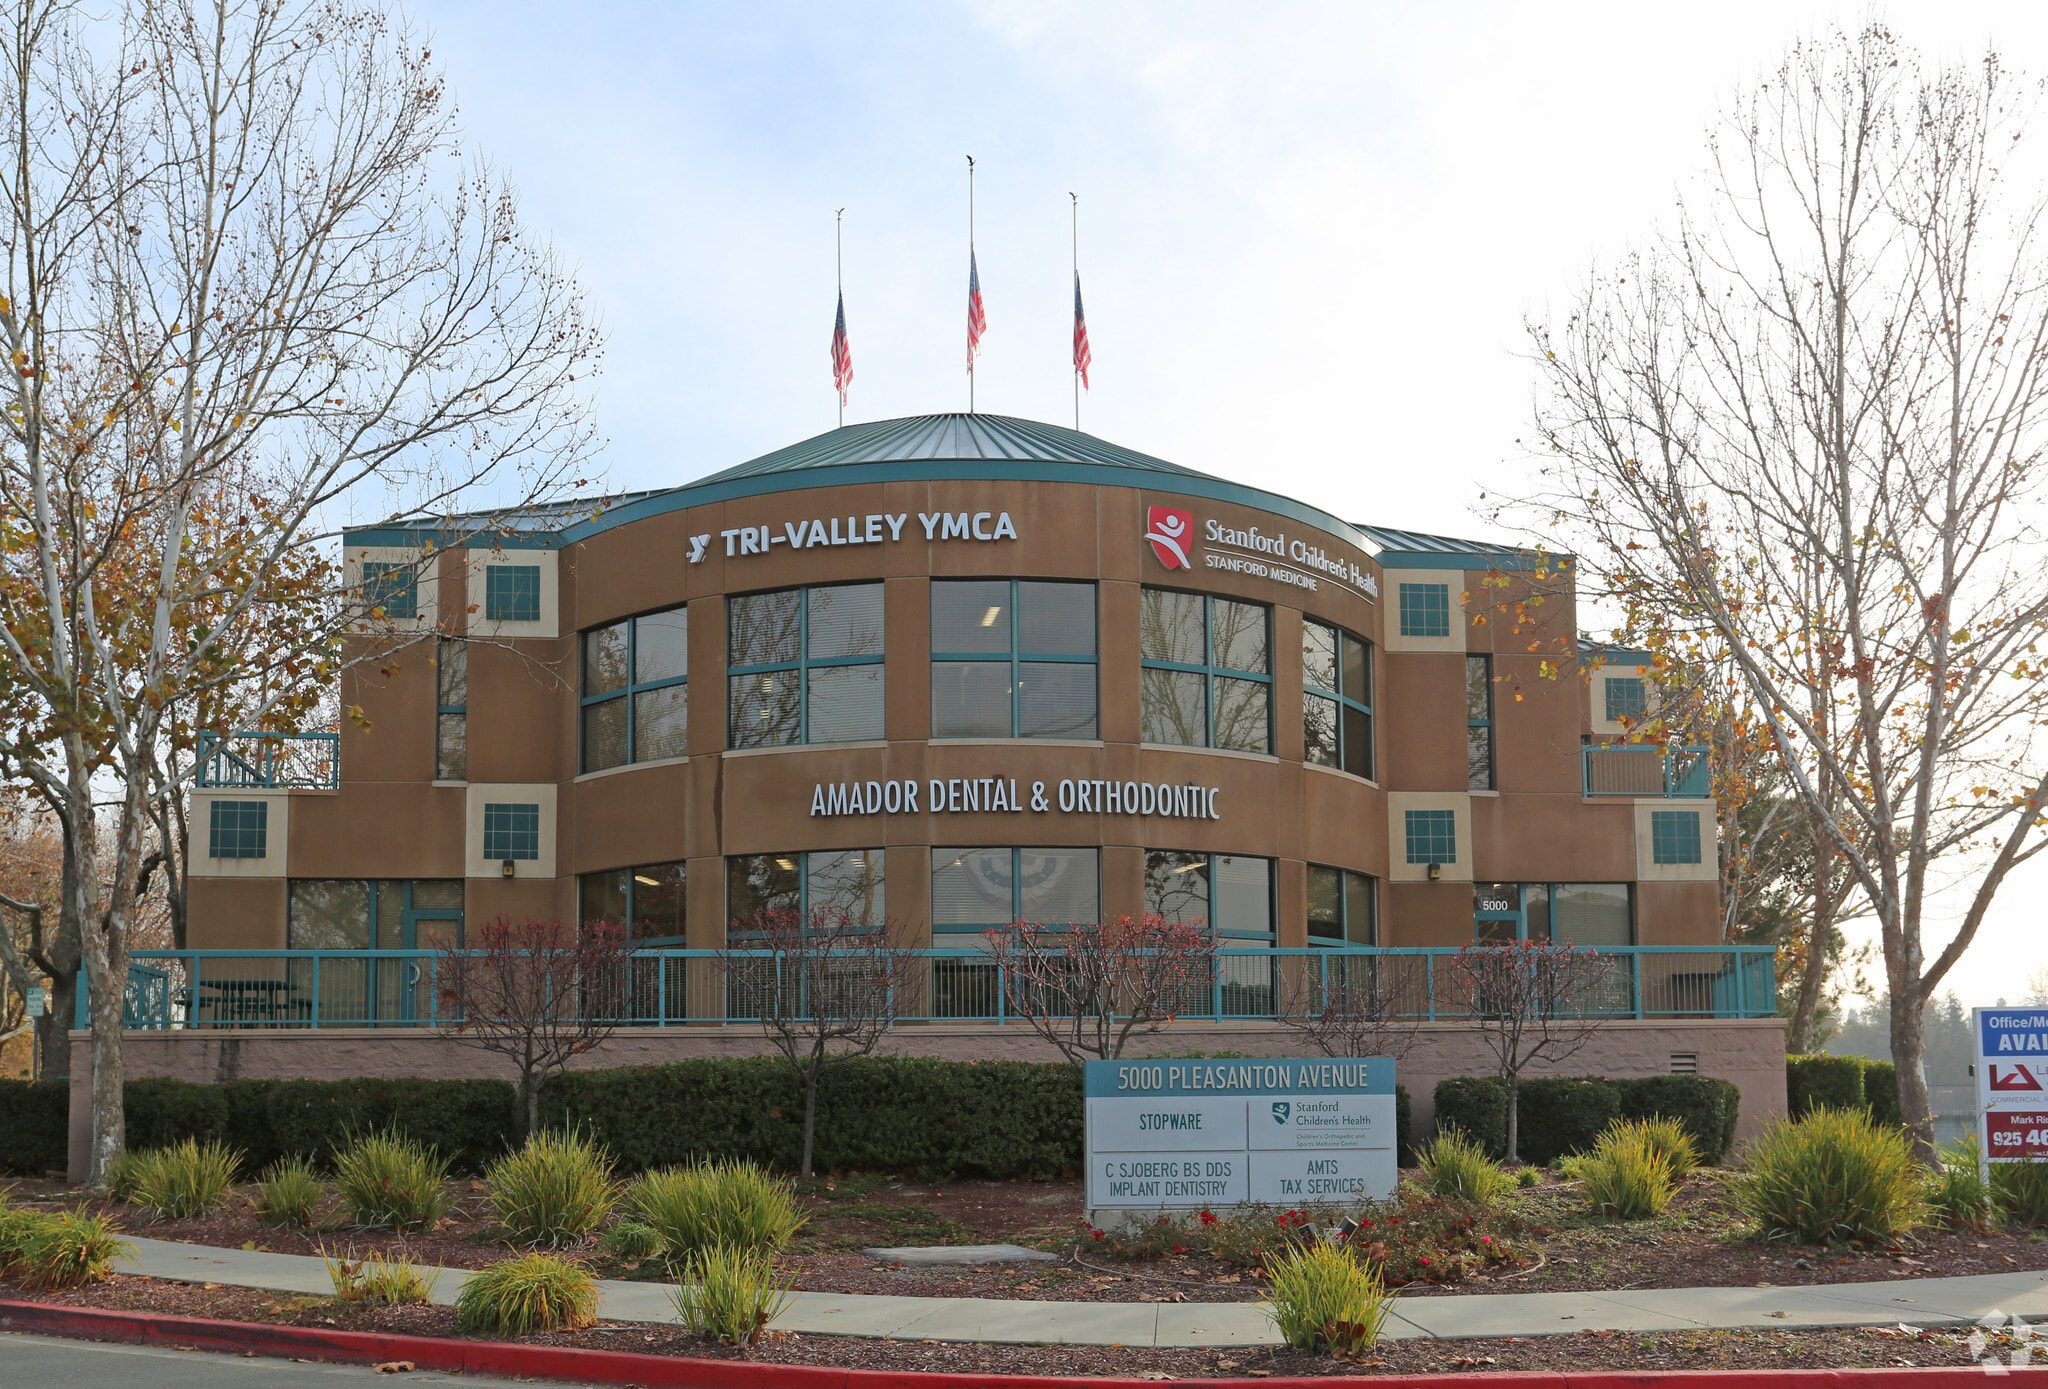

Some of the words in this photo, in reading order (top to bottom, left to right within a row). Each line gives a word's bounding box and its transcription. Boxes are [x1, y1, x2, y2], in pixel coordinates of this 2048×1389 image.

[721, 513, 907, 557] TRI-VALLEY
[918, 511, 1017, 541] YMCA
[1205, 519, 1286, 557] Stanford
[1290, 540, 1348, 580] Children's
[1350, 562, 1378, 598] Health
[1206, 554, 1268, 578] STANFORD
[1270, 567, 1318, 592] MEDICINE
[810, 780, 919, 816] AMADOR
[929, 778, 1023, 812] DENTAL
[1030, 780, 1050, 813] &
[1058, 779, 1220, 820] ORTHODONTIC
[1482, 900, 1508, 911] 5000
[1117, 1066, 1163, 1090] 5000
[1169, 1065, 1290, 1090] PLEASANTON
[1297, 1064, 1368, 1088] AVENUE
[1296, 1101, 1339, 1112] Stanford
[1139, 1113, 1202, 1130] STOPWARE
[1296, 1115, 1339, 1126] Children's
[1342, 1115, 1371, 1126] Health
[2010, 1115, 2034, 1124] Mark
[1324, 1133, 1354, 1141] Orthopedic
[1993, 1131, 2022, 1146] 925
[1105, 1162, 1114, 1178] C
[1119, 1162, 1178, 1178] SJOBERG
[1183, 1162, 1200, 1177] BS
[1206, 1161, 1232, 1177] DDS
[1306, 1159, 1339, 1175] AMTS
[1110, 1181, 1160, 1197] IMPLANT
[1165, 1180, 1227, 1197] DENTISTRY
[1280, 1179, 1302, 1194] TAX
[1307, 1178, 1365, 1194] SERVICES
